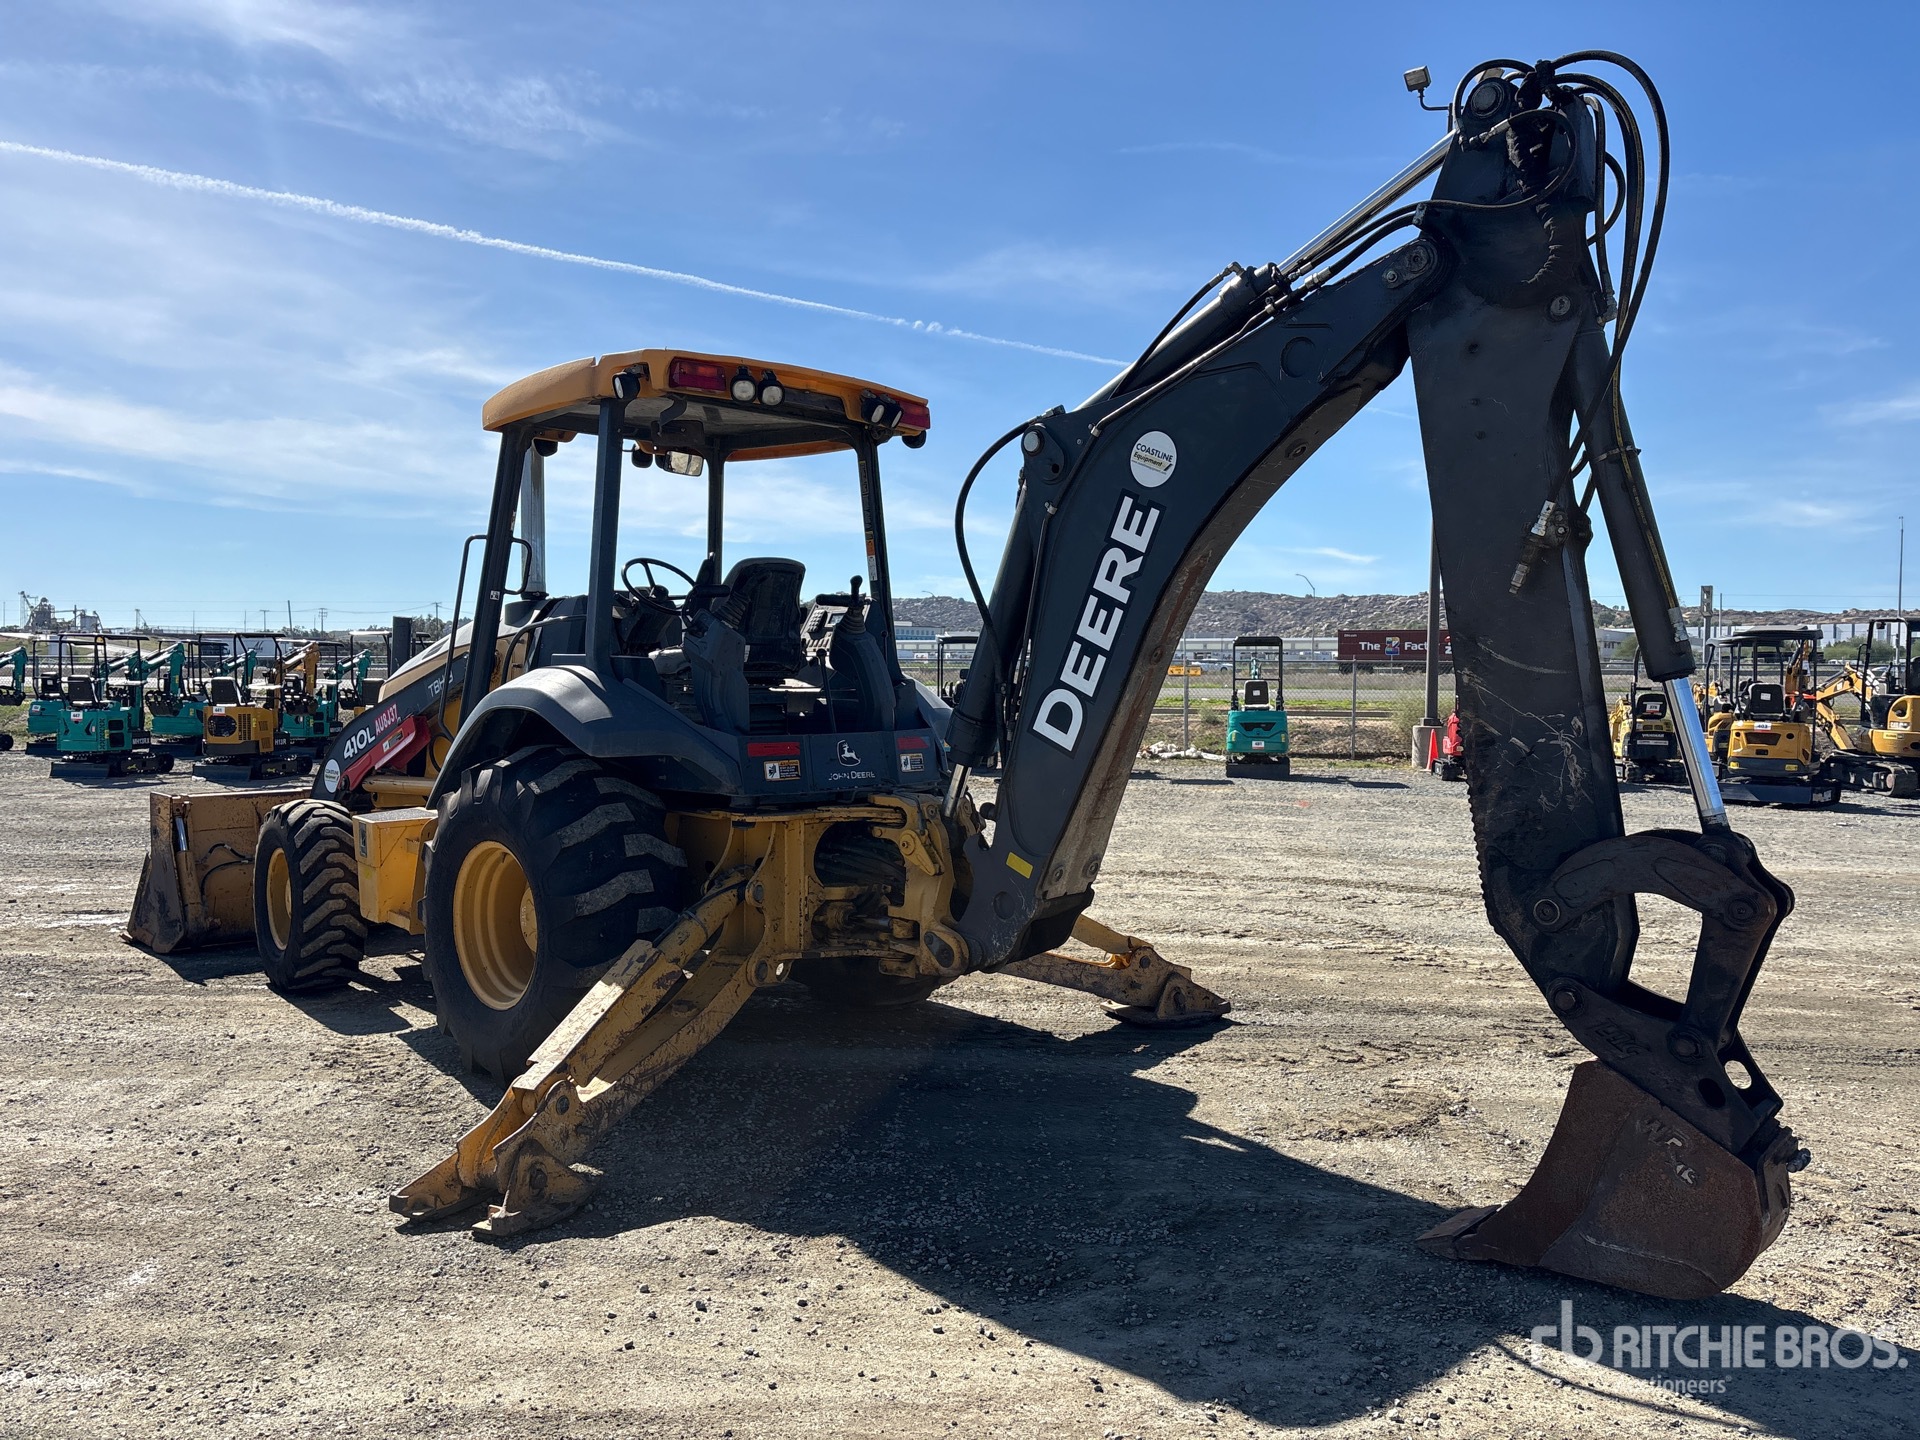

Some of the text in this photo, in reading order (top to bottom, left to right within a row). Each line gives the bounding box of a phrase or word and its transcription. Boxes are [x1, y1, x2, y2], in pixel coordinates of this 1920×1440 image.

[1133, 452, 1163, 467] Equipment
[1135, 442, 1174, 463] COASTLINE
[1033, 495, 1160, 752] DEERE
[1359, 641, 1381, 651] The
[343, 727, 376, 759] 410L
[374, 704, 398, 736] AU8J37
